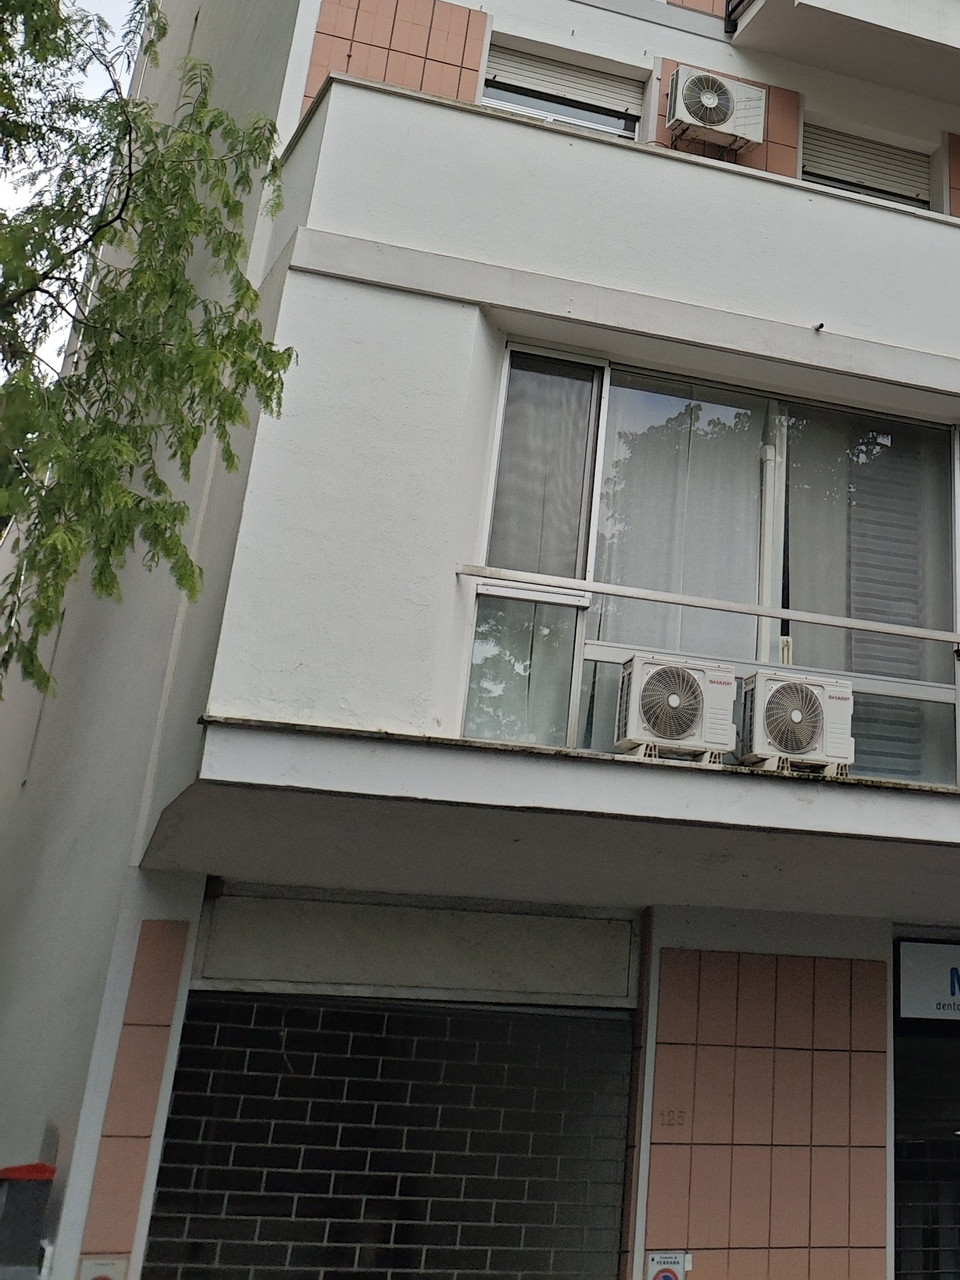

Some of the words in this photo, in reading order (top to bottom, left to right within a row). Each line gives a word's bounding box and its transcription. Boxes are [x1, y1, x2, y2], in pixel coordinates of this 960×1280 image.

[709, 679, 733, 687] SHARP
[828, 694, 850, 702] SHARP
[659, 1109, 686, 1126] 125
